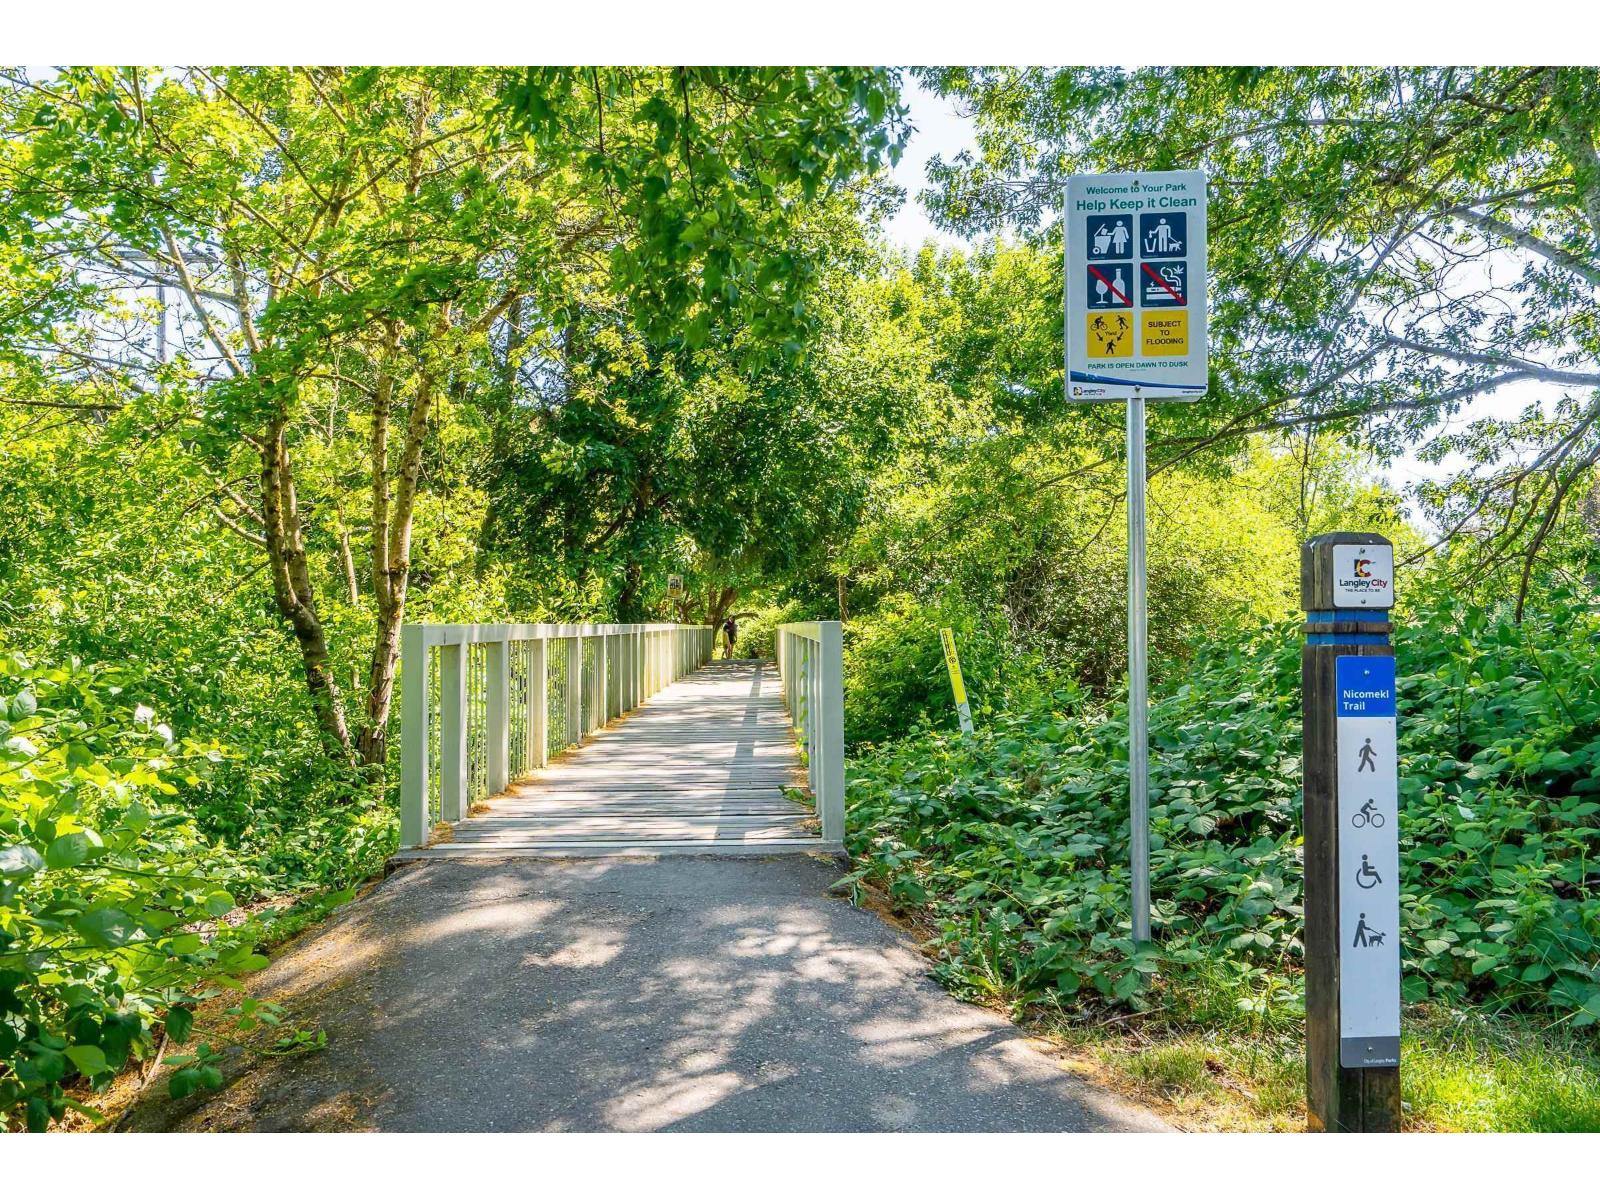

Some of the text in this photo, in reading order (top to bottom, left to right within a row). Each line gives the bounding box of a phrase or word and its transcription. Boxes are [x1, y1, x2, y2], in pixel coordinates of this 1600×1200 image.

[1086, 183, 1187, 195] Welcome to Your Park
[1076, 196, 1197, 212] Help Keep it Clean
[1147, 320, 1182, 328] SUBJECT
[1146, 337, 1184, 345] FLOODING
[1339, 579, 1388, 589] Langley City
[1343, 689, 1389, 699] Nicomekl
[1343, 701, 1366, 710] Trail
